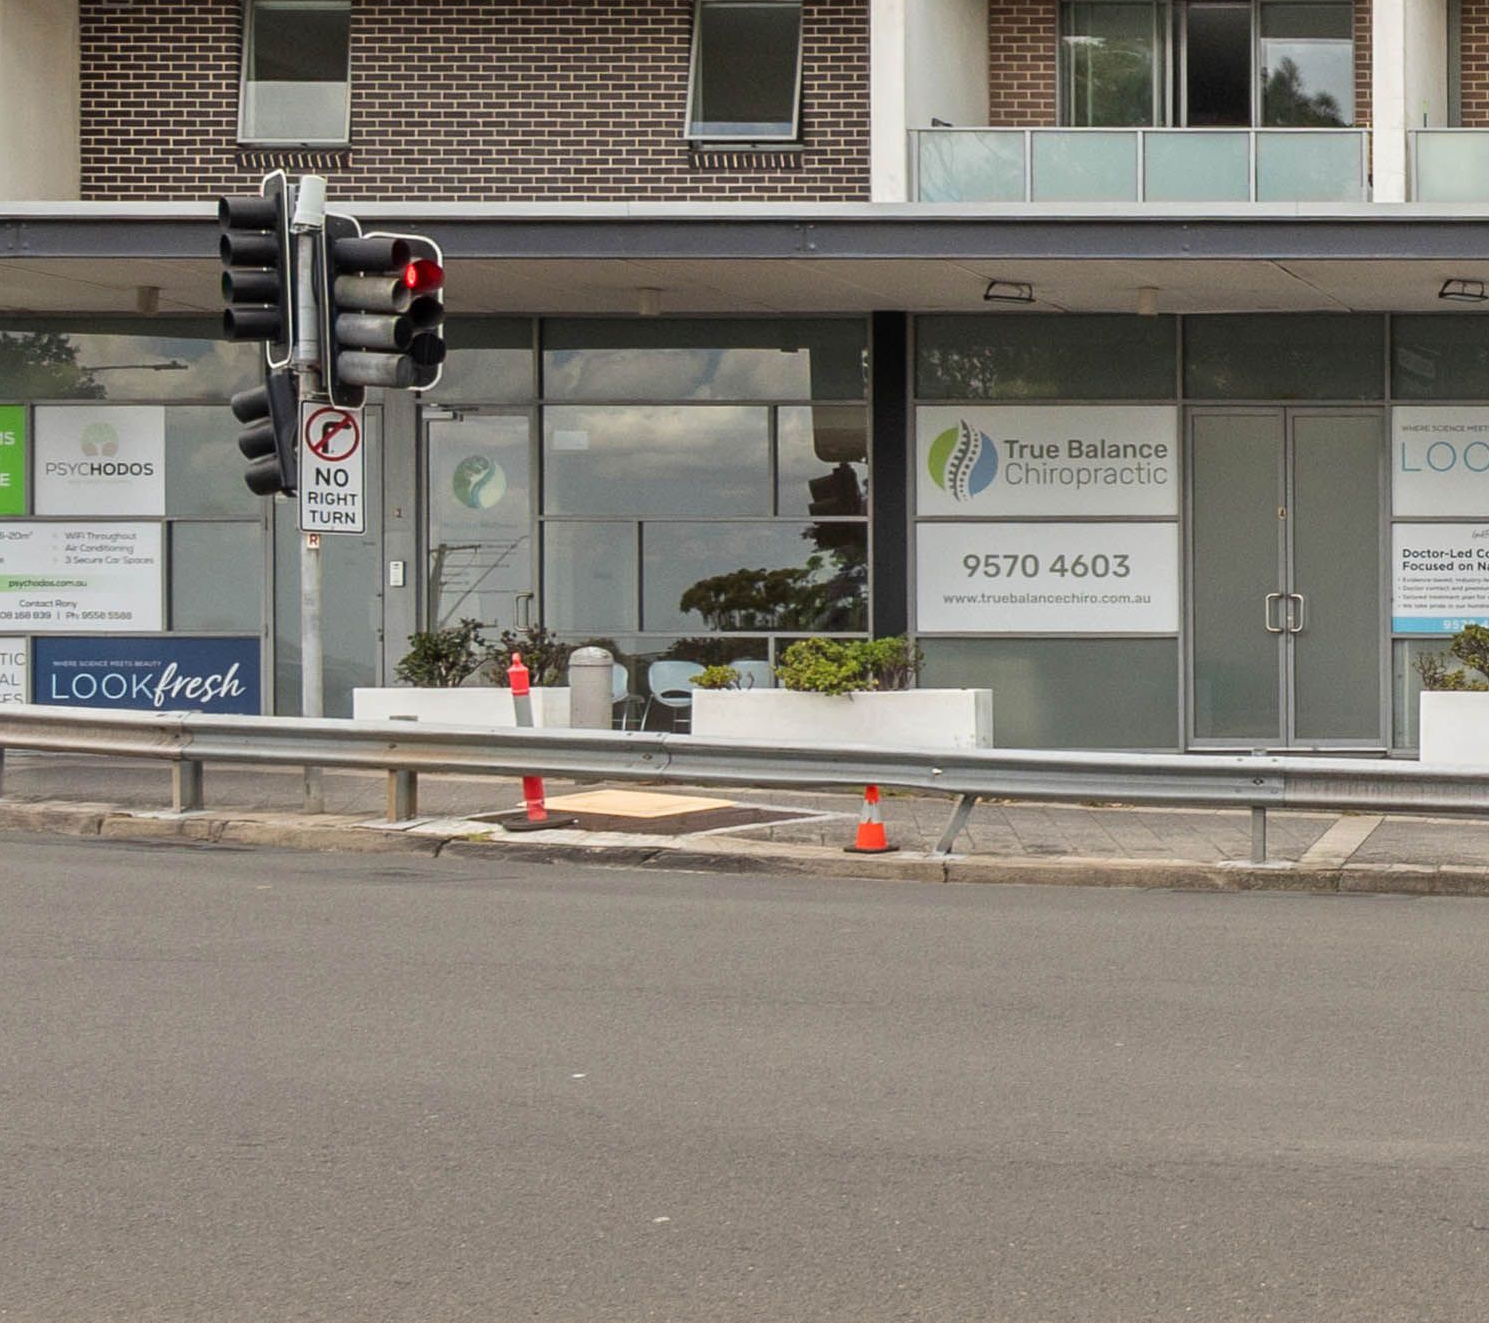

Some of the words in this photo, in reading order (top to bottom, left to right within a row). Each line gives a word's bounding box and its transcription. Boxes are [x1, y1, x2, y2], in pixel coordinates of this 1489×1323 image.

[1003, 439, 1060, 460] True
[1067, 438, 1168, 460] Balance
[45, 462, 155, 477] PSYCHODOS
[315, 467, 349, 487] NO
[1004, 461, 1168, 490] Chiropractic
[307, 491, 359, 506] RIGHT
[309, 510, 356, 525] TURN
[1401, 548, 1473, 559] Doctor-Led
[962, 553, 1040, 578] 9570
[1048, 553, 1131, 578] 4603
[1401, 561, 1454, 572] Focused
[1458, 563, 1474, 572] on
[8, 579, 88, 589] psychodos.com.au
[18, 599, 54, 608] Contact
[942, 592, 1152, 605] www.truebalancechiro.com.au
